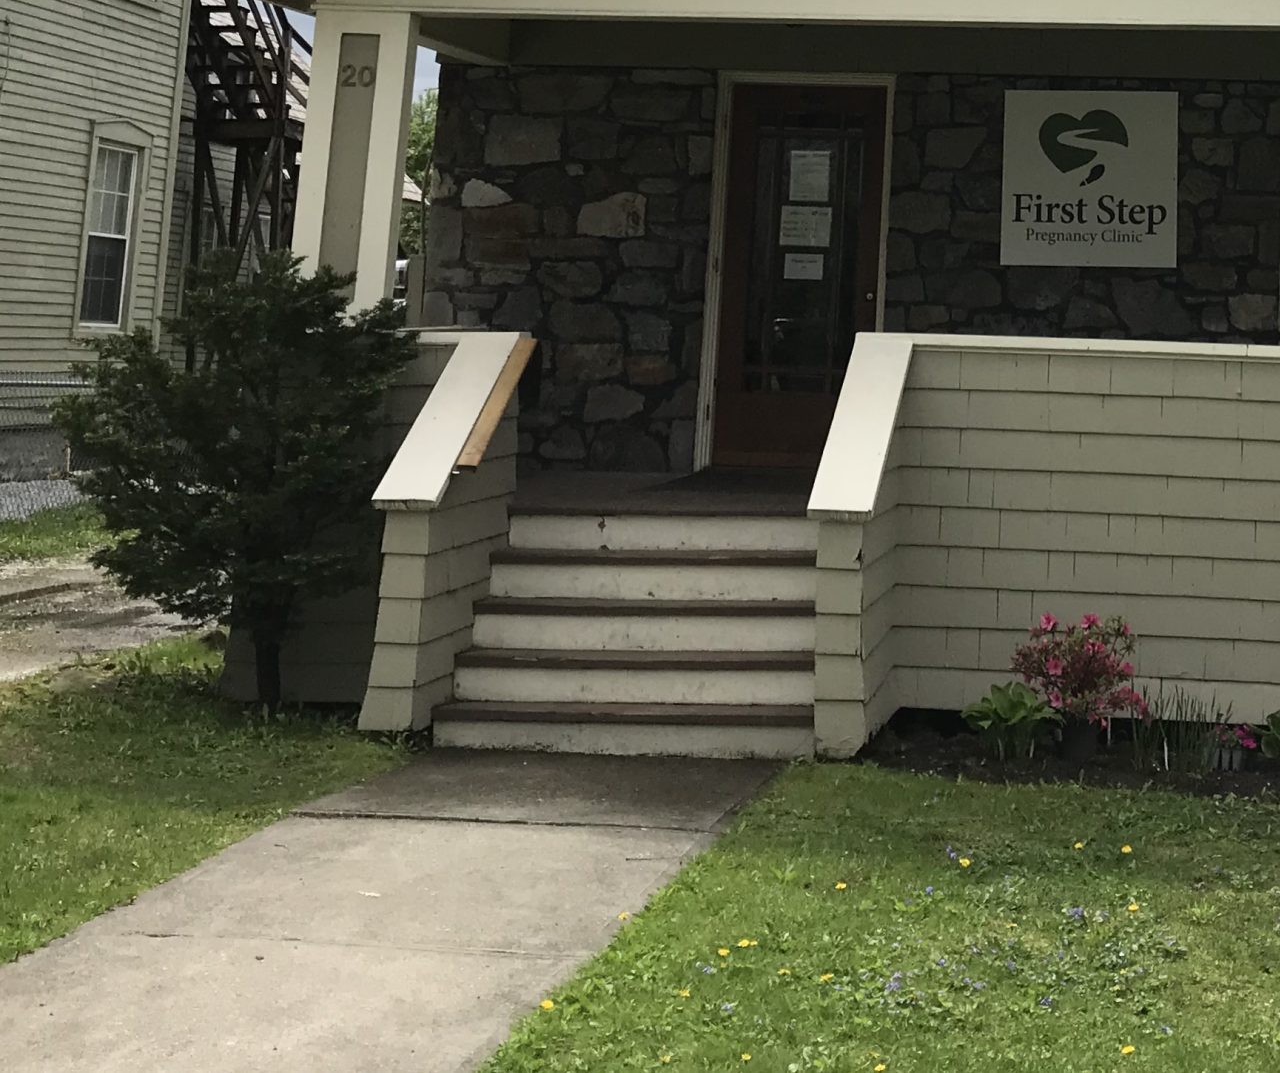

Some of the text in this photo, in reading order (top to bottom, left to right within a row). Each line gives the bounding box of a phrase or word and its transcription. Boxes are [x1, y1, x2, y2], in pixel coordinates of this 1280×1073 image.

[341, 64, 375, 87] 20
[1012, 193, 1167, 235] First Step
[1026, 228, 1143, 245] Pregnancy Clinic
